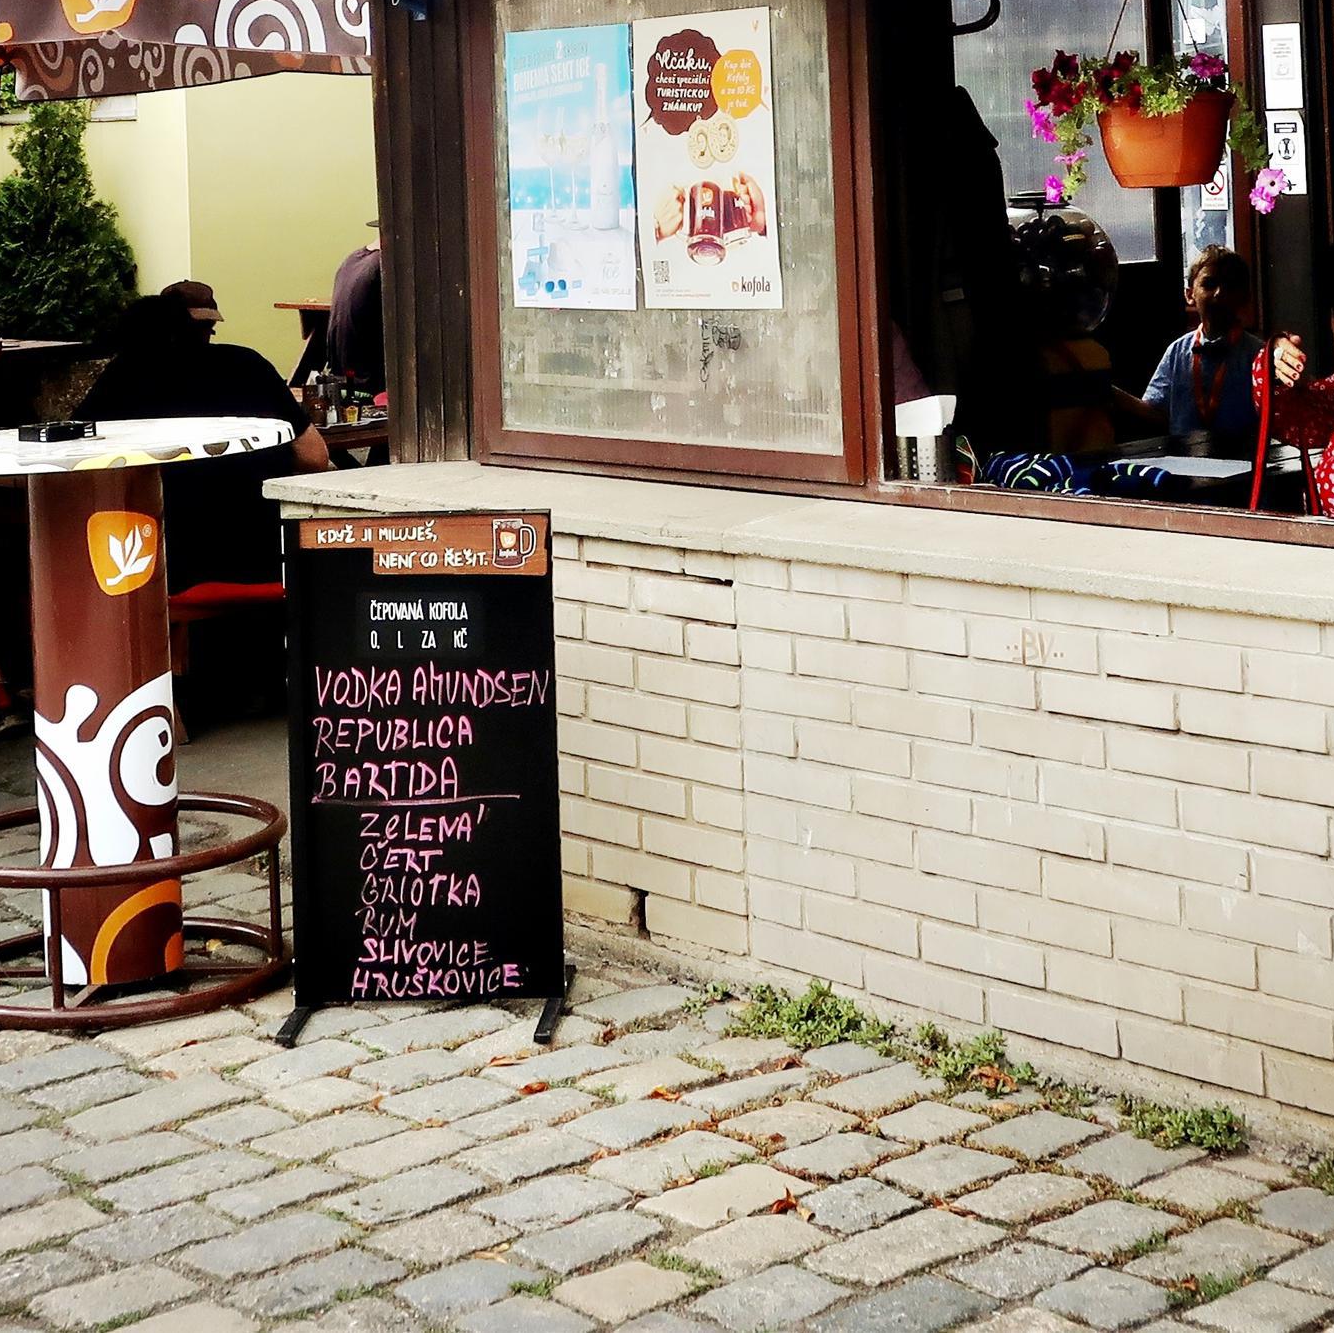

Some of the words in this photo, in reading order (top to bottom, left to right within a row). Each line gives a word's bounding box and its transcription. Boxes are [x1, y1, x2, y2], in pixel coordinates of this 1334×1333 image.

[655, 48, 712, 72] Vlčáku,
[655, 72, 676, 84] chceš
[656, 88, 710, 99] TURISTICKOU
[662, 99, 703, 112] ZNÁMKU?
[741, 276, 771, 298] kofola
[317, 524, 355, 544] KDYŽ
[361, 527, 372, 543] JI
[378, 519, 438, 543] MILUJEŠ,
[378, 551, 417, 569] NENÍ
[420, 551, 438, 568] CO
[444, 547, 489, 567] ŘEŠIT.
[370, 598, 424, 621] ČEPOVANÁ
[429, 601, 468, 621] KOFOLA
[397, 630, 404, 649] L
[421, 630, 436, 649] ZA
[453, 627, 468, 649] KČ
[315, 665, 401, 712] VODKA
[412, 660, 549, 708] AMUNDSEN
[313, 715, 473, 757] REPUBLICA
[315, 756, 458, 800] BARTIDA
[360, 840, 444, 874] ČERT
[361, 872, 481, 907] GRIOTKA
[354, 906, 417, 941] RUM
[358, 937, 494, 967] SLIVOVICE
[351, 963, 524, 999] HRUŠKOVICE
